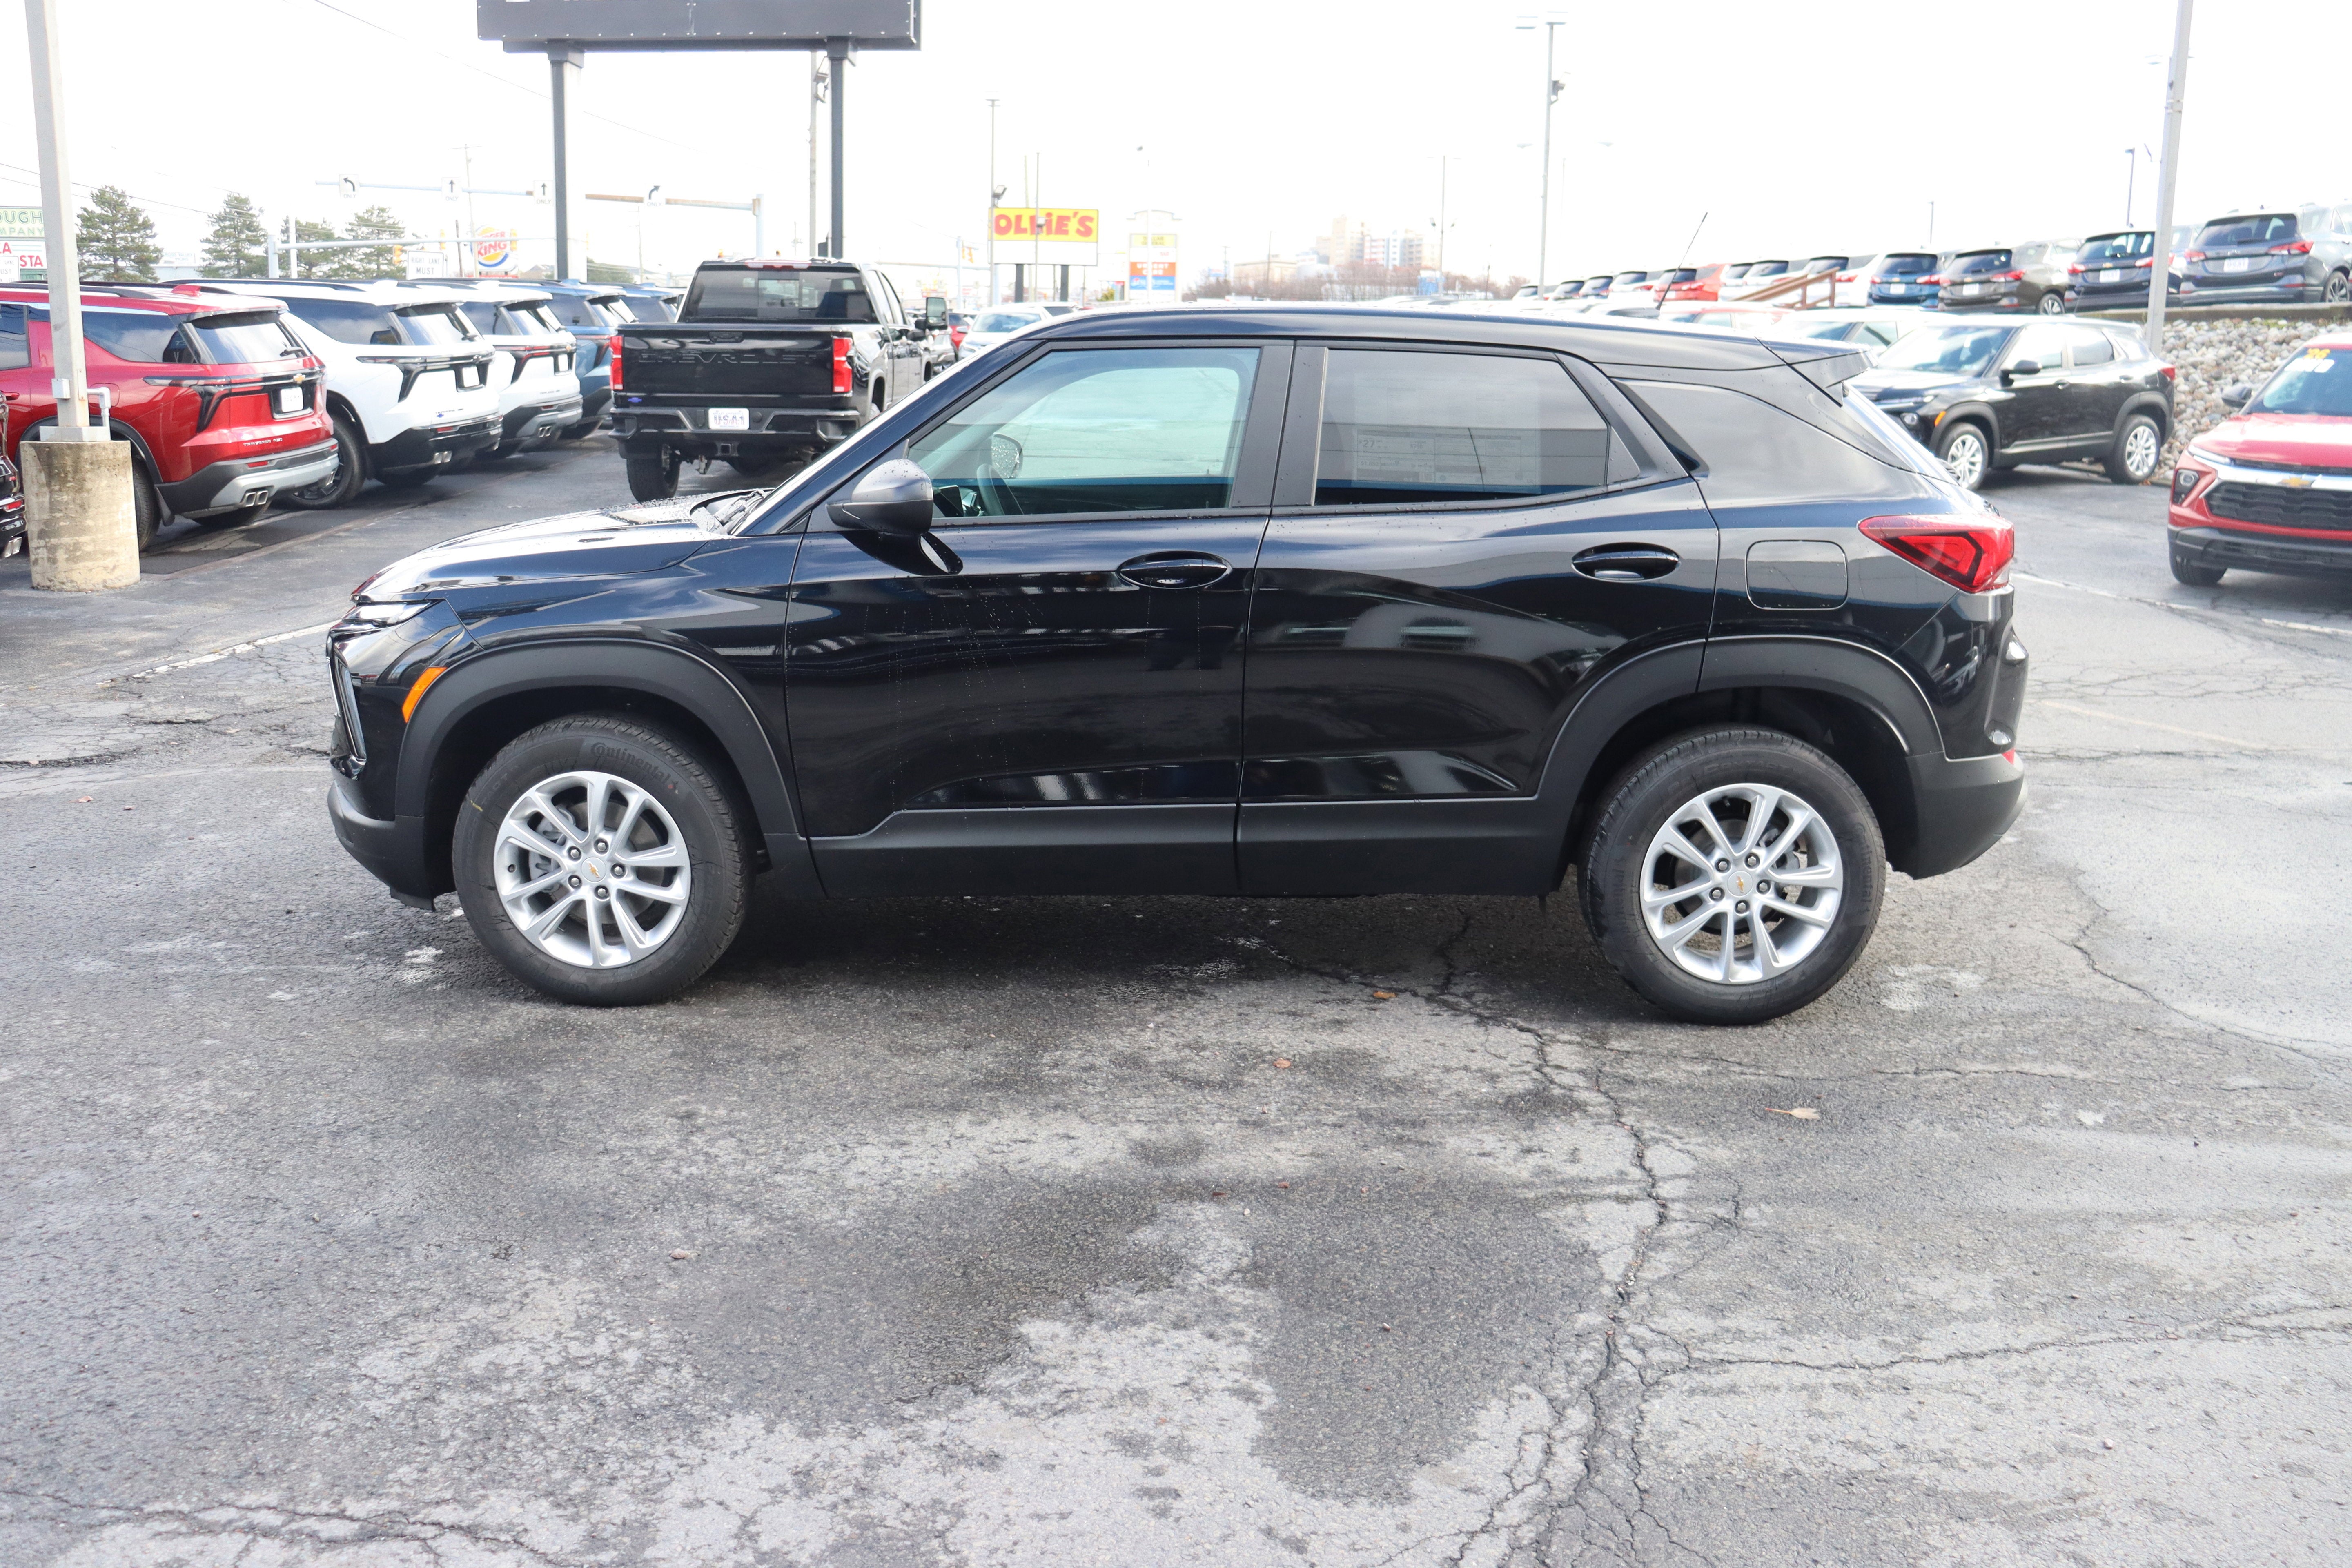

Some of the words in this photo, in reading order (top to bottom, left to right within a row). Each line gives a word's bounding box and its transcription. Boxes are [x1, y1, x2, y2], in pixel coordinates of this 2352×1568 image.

[478, 240, 507, 256] KING
[639, 352, 817, 364] CHEVROLET
[714, 415, 744, 425] USA1
[591, 742, 671, 784] Continental
